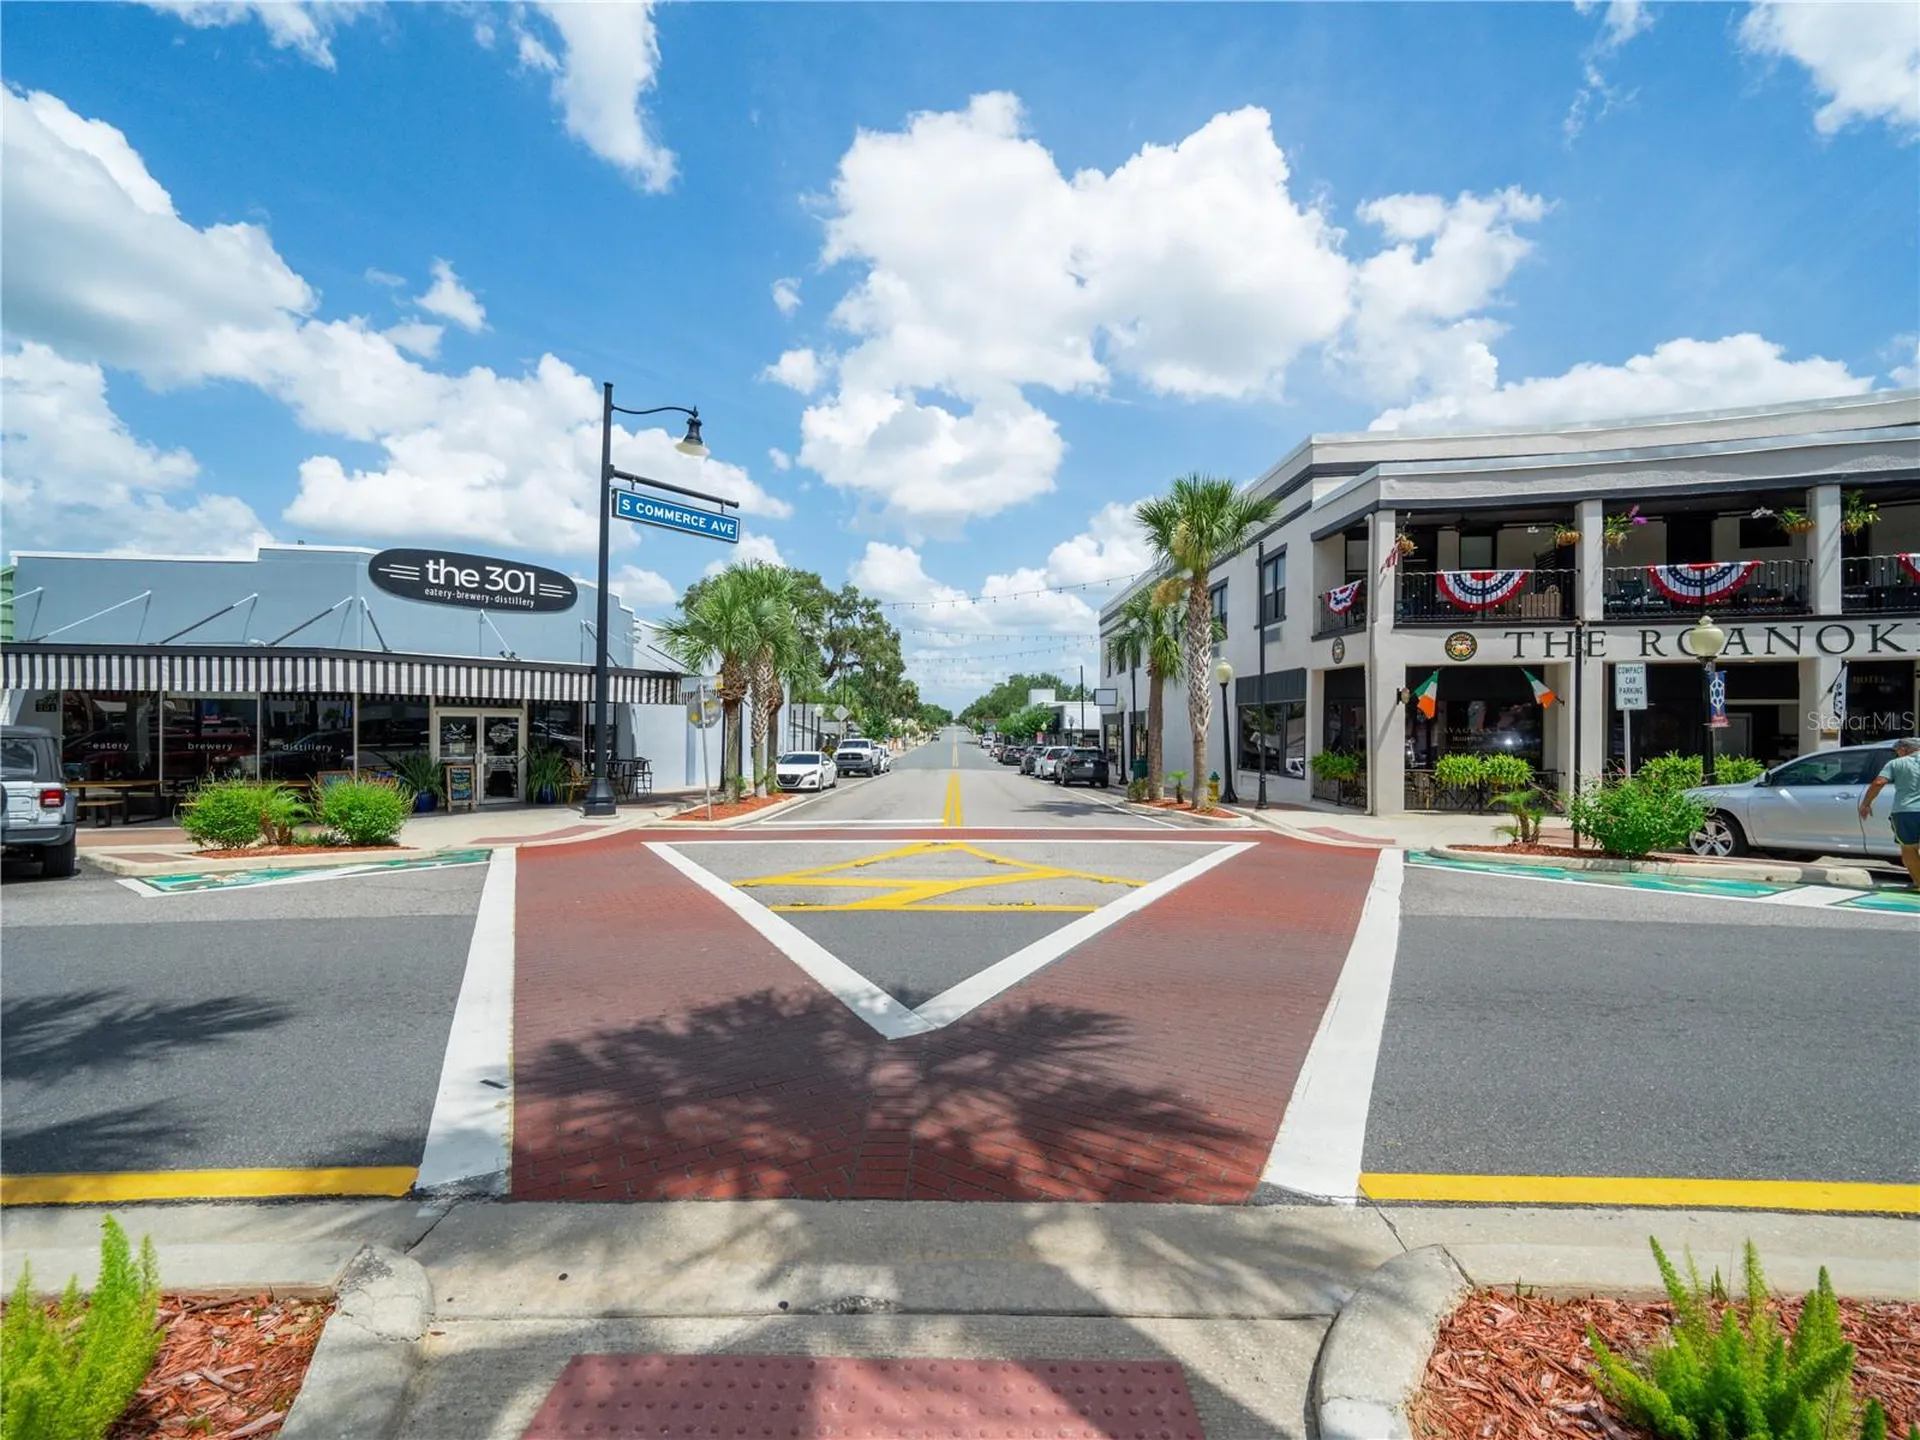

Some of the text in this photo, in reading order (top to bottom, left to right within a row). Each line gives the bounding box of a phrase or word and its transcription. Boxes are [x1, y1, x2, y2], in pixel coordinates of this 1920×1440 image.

[622, 499, 735, 535] S COMMERCE AVE
[425, 558, 536, 596] the 301
[1504, 630, 1607, 659] THE
[1618, 666, 1644, 675] COMPACT
[1625, 677, 1637, 685] CAR
[1619, 687, 1644, 695] PARKING
[1623, 697, 1639, 705] ONLY
[92, 742, 130, 752] eatery
[187, 742, 233, 752] brewery
[282, 743, 333, 753] distillery
